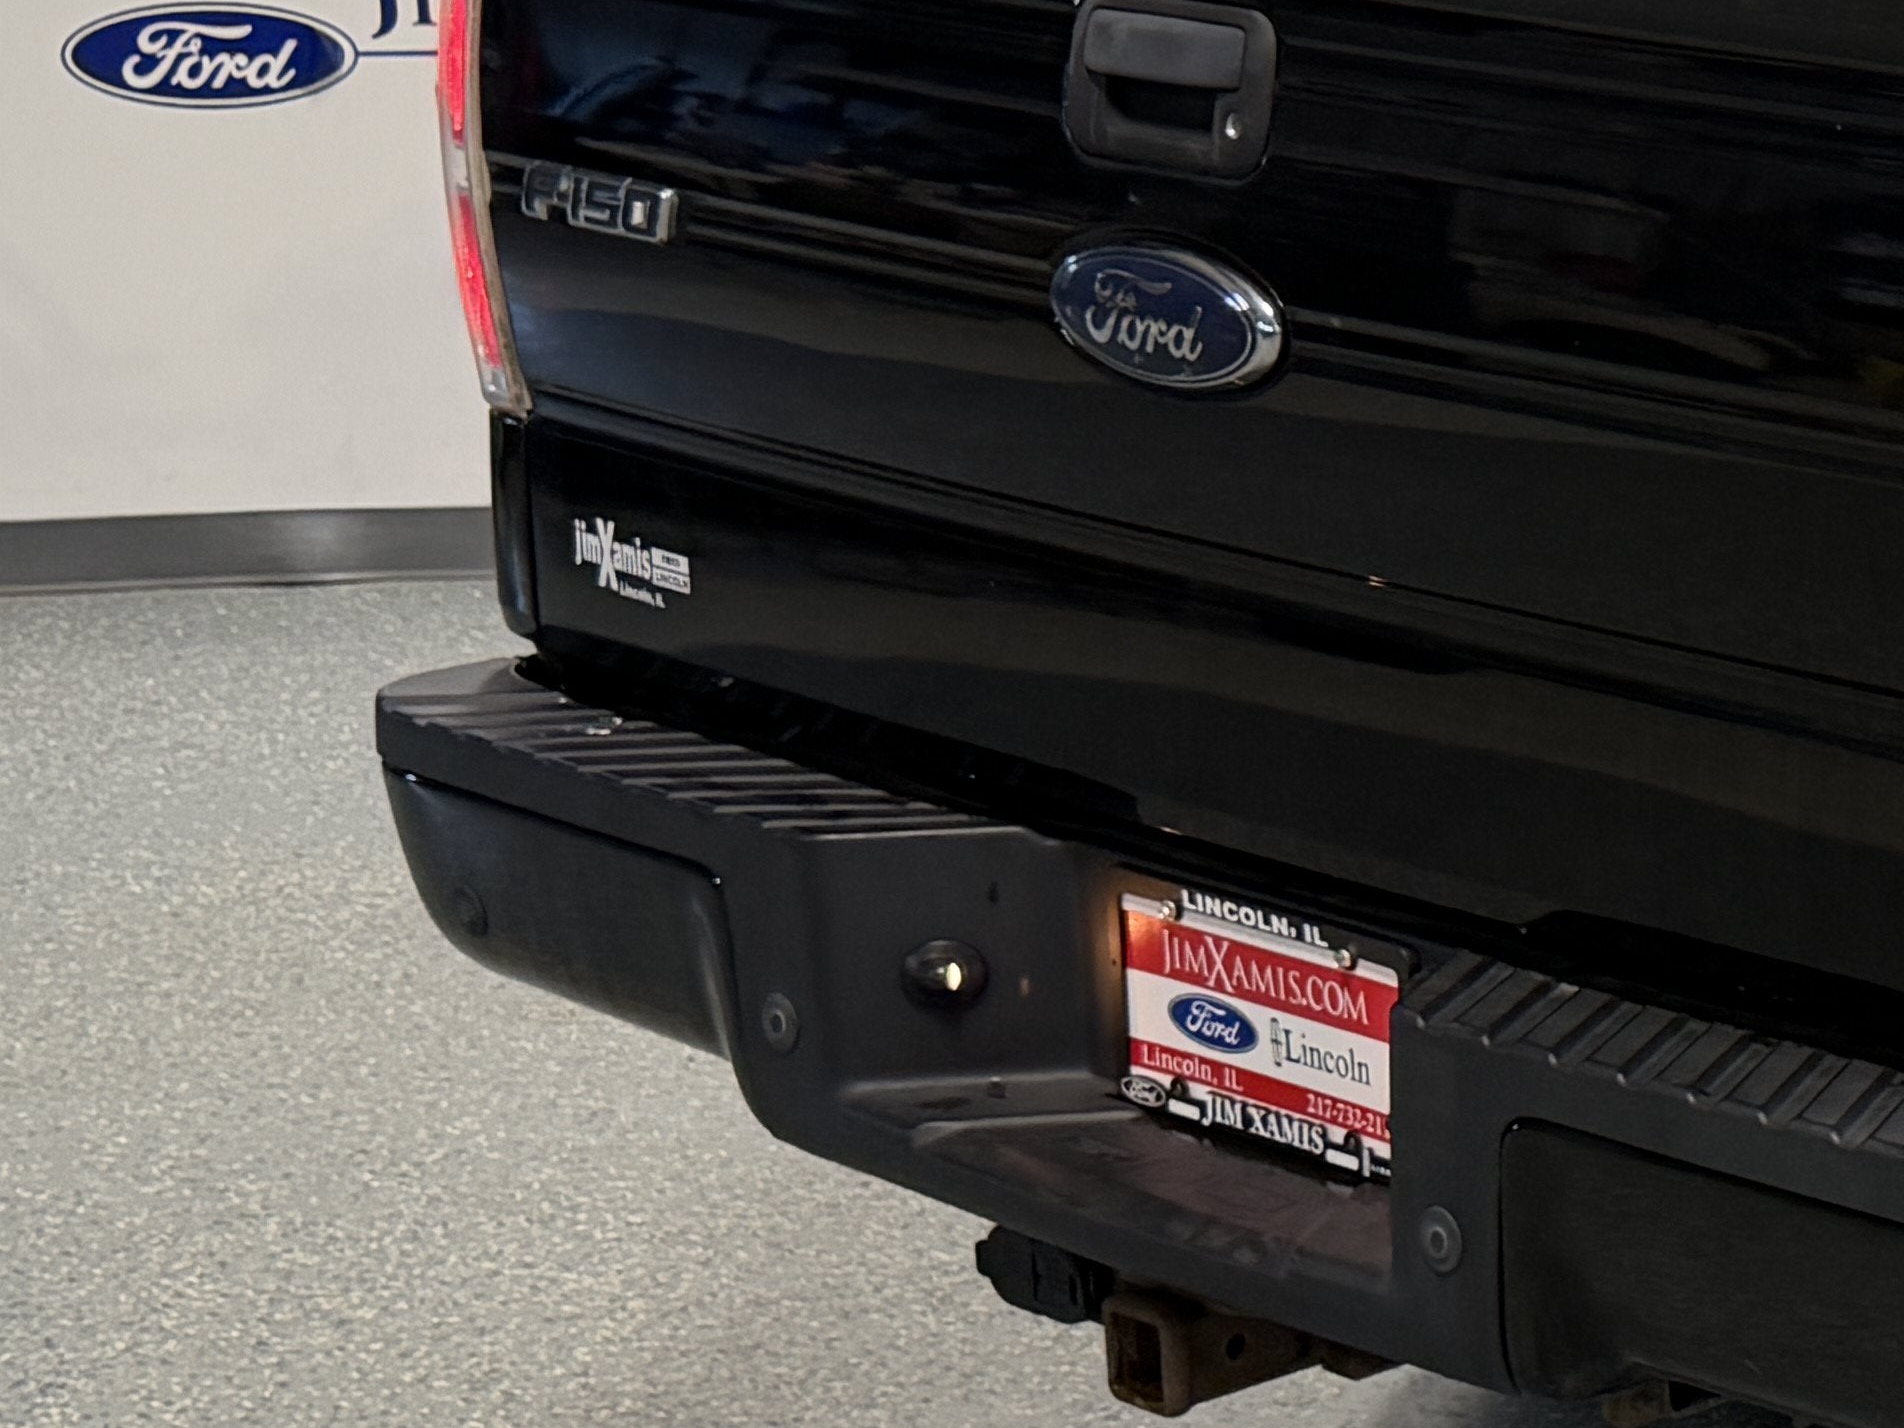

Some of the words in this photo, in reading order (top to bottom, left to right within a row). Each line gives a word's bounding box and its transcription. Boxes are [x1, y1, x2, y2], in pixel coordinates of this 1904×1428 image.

[121, 20, 299, 91] Ford
[519, 159, 679, 245] F-150
[1084, 268, 1203, 362] Ford
[1179, 888, 1297, 938] LINCOLN,
[1302, 922, 1329, 948] IL
[1185, 999, 1241, 1047] Ford
[1283, 1028, 1371, 1086] Lincoln
[1201, 1091, 1245, 1127] JIM
[1247, 1106, 1326, 1156] XAMIS
